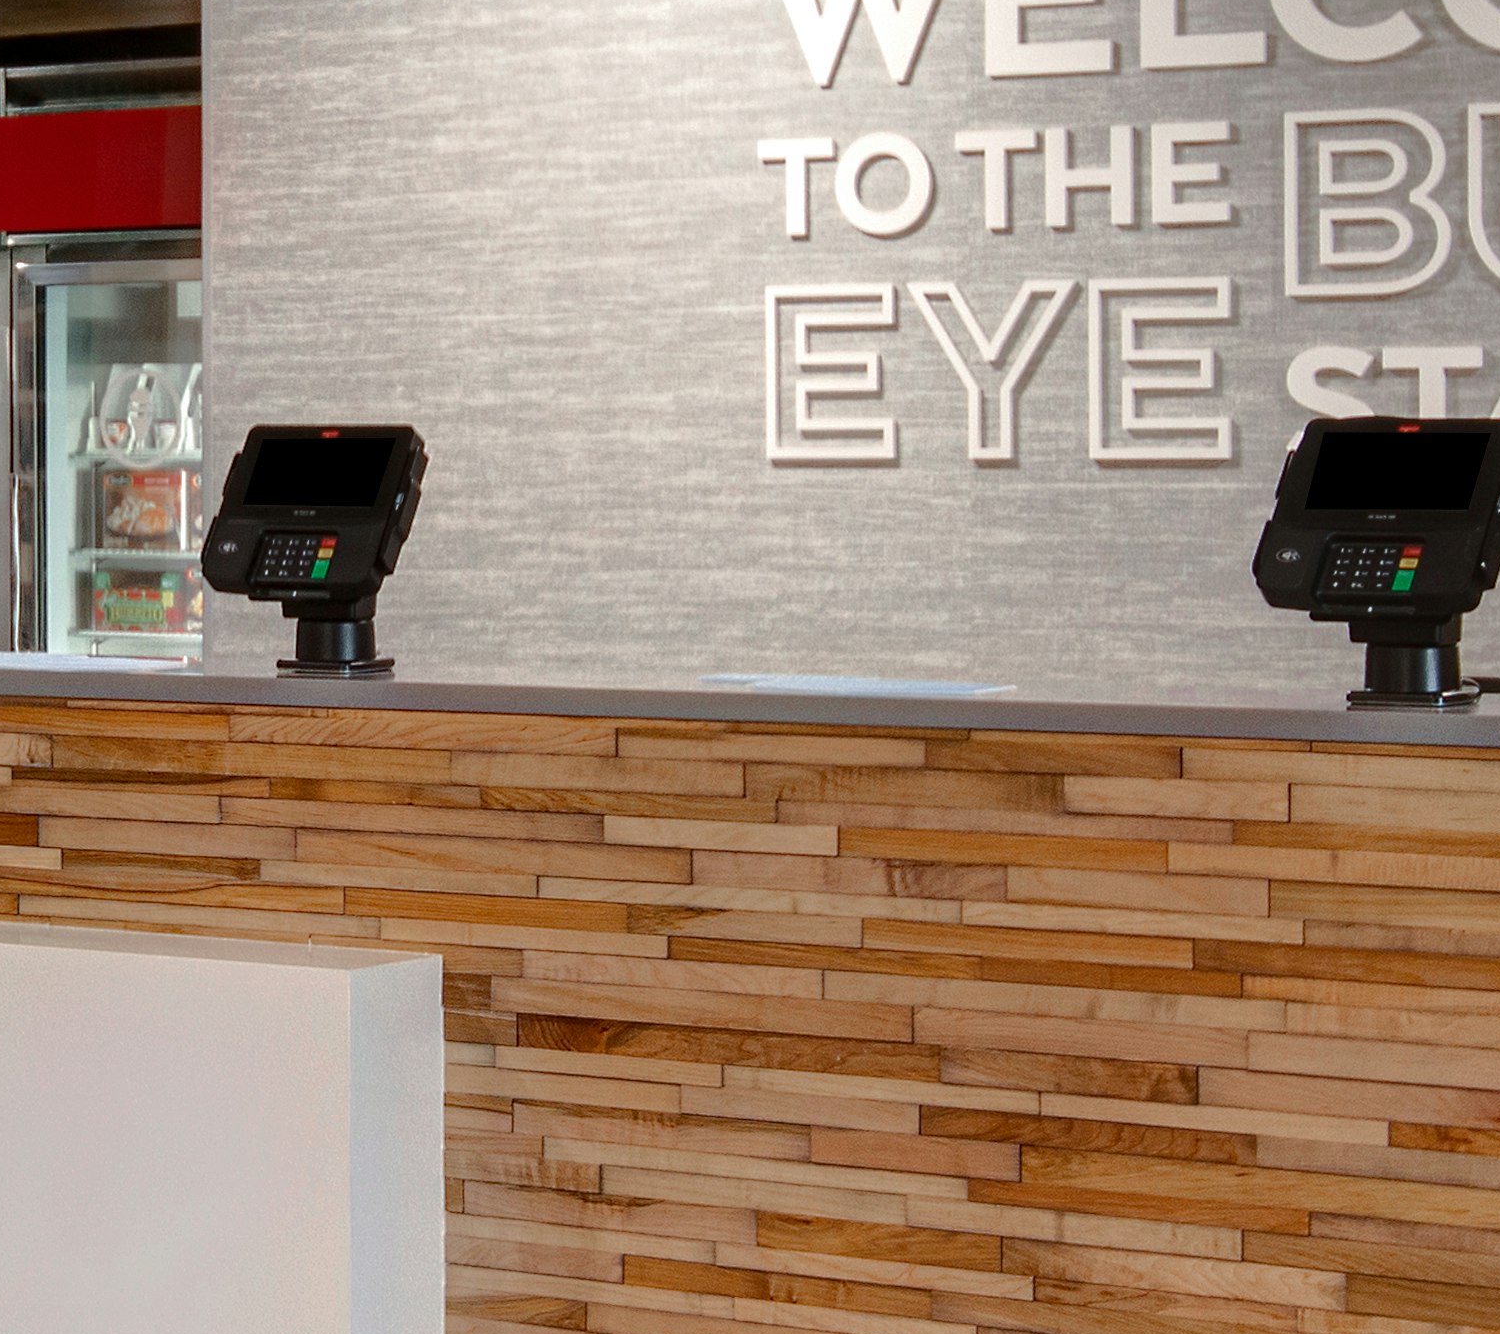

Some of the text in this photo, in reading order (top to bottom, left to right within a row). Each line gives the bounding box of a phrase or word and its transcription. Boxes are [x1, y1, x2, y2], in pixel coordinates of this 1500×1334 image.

[757, 132, 936, 238] TO
[955, 120, 1232, 230] THE
[764, 276, 1233, 464] EYE
